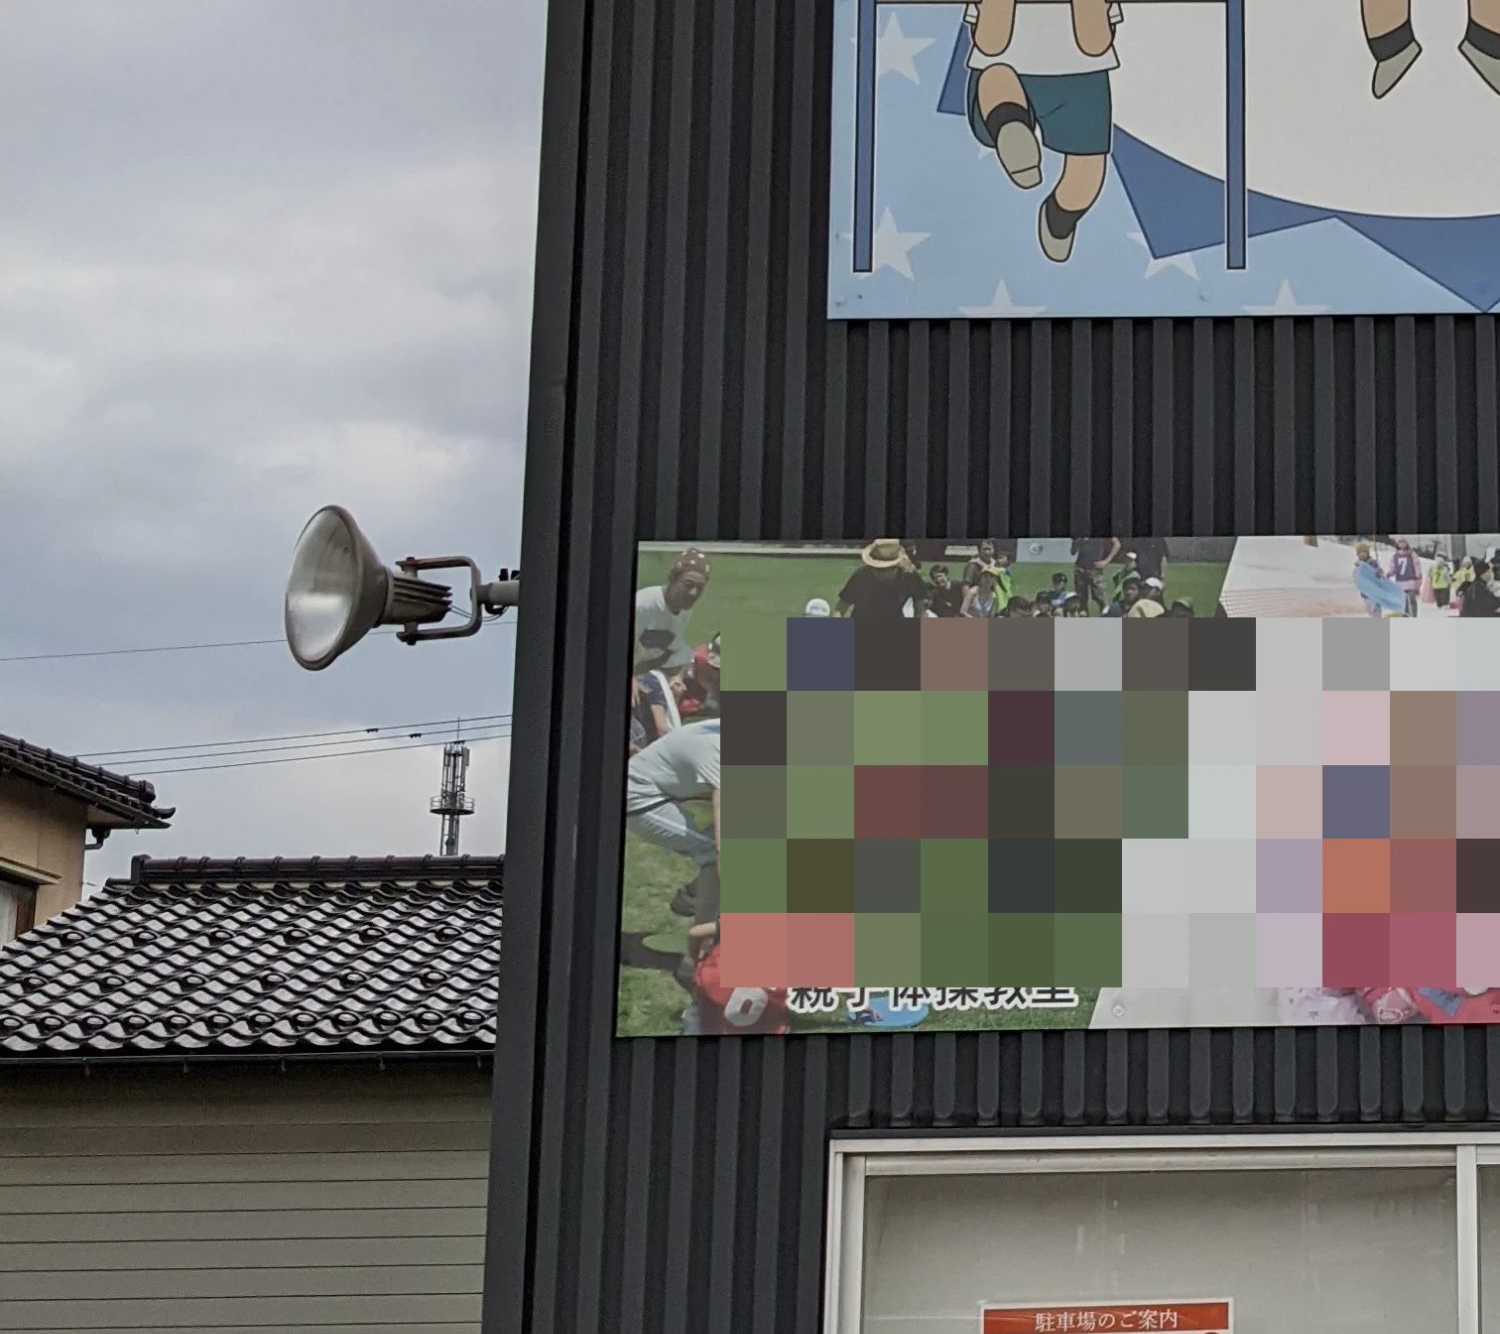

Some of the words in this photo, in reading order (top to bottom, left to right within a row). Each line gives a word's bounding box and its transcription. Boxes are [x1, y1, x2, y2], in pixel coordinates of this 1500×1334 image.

[1035, 1308, 1178, 1333] 駐車場のご案内
